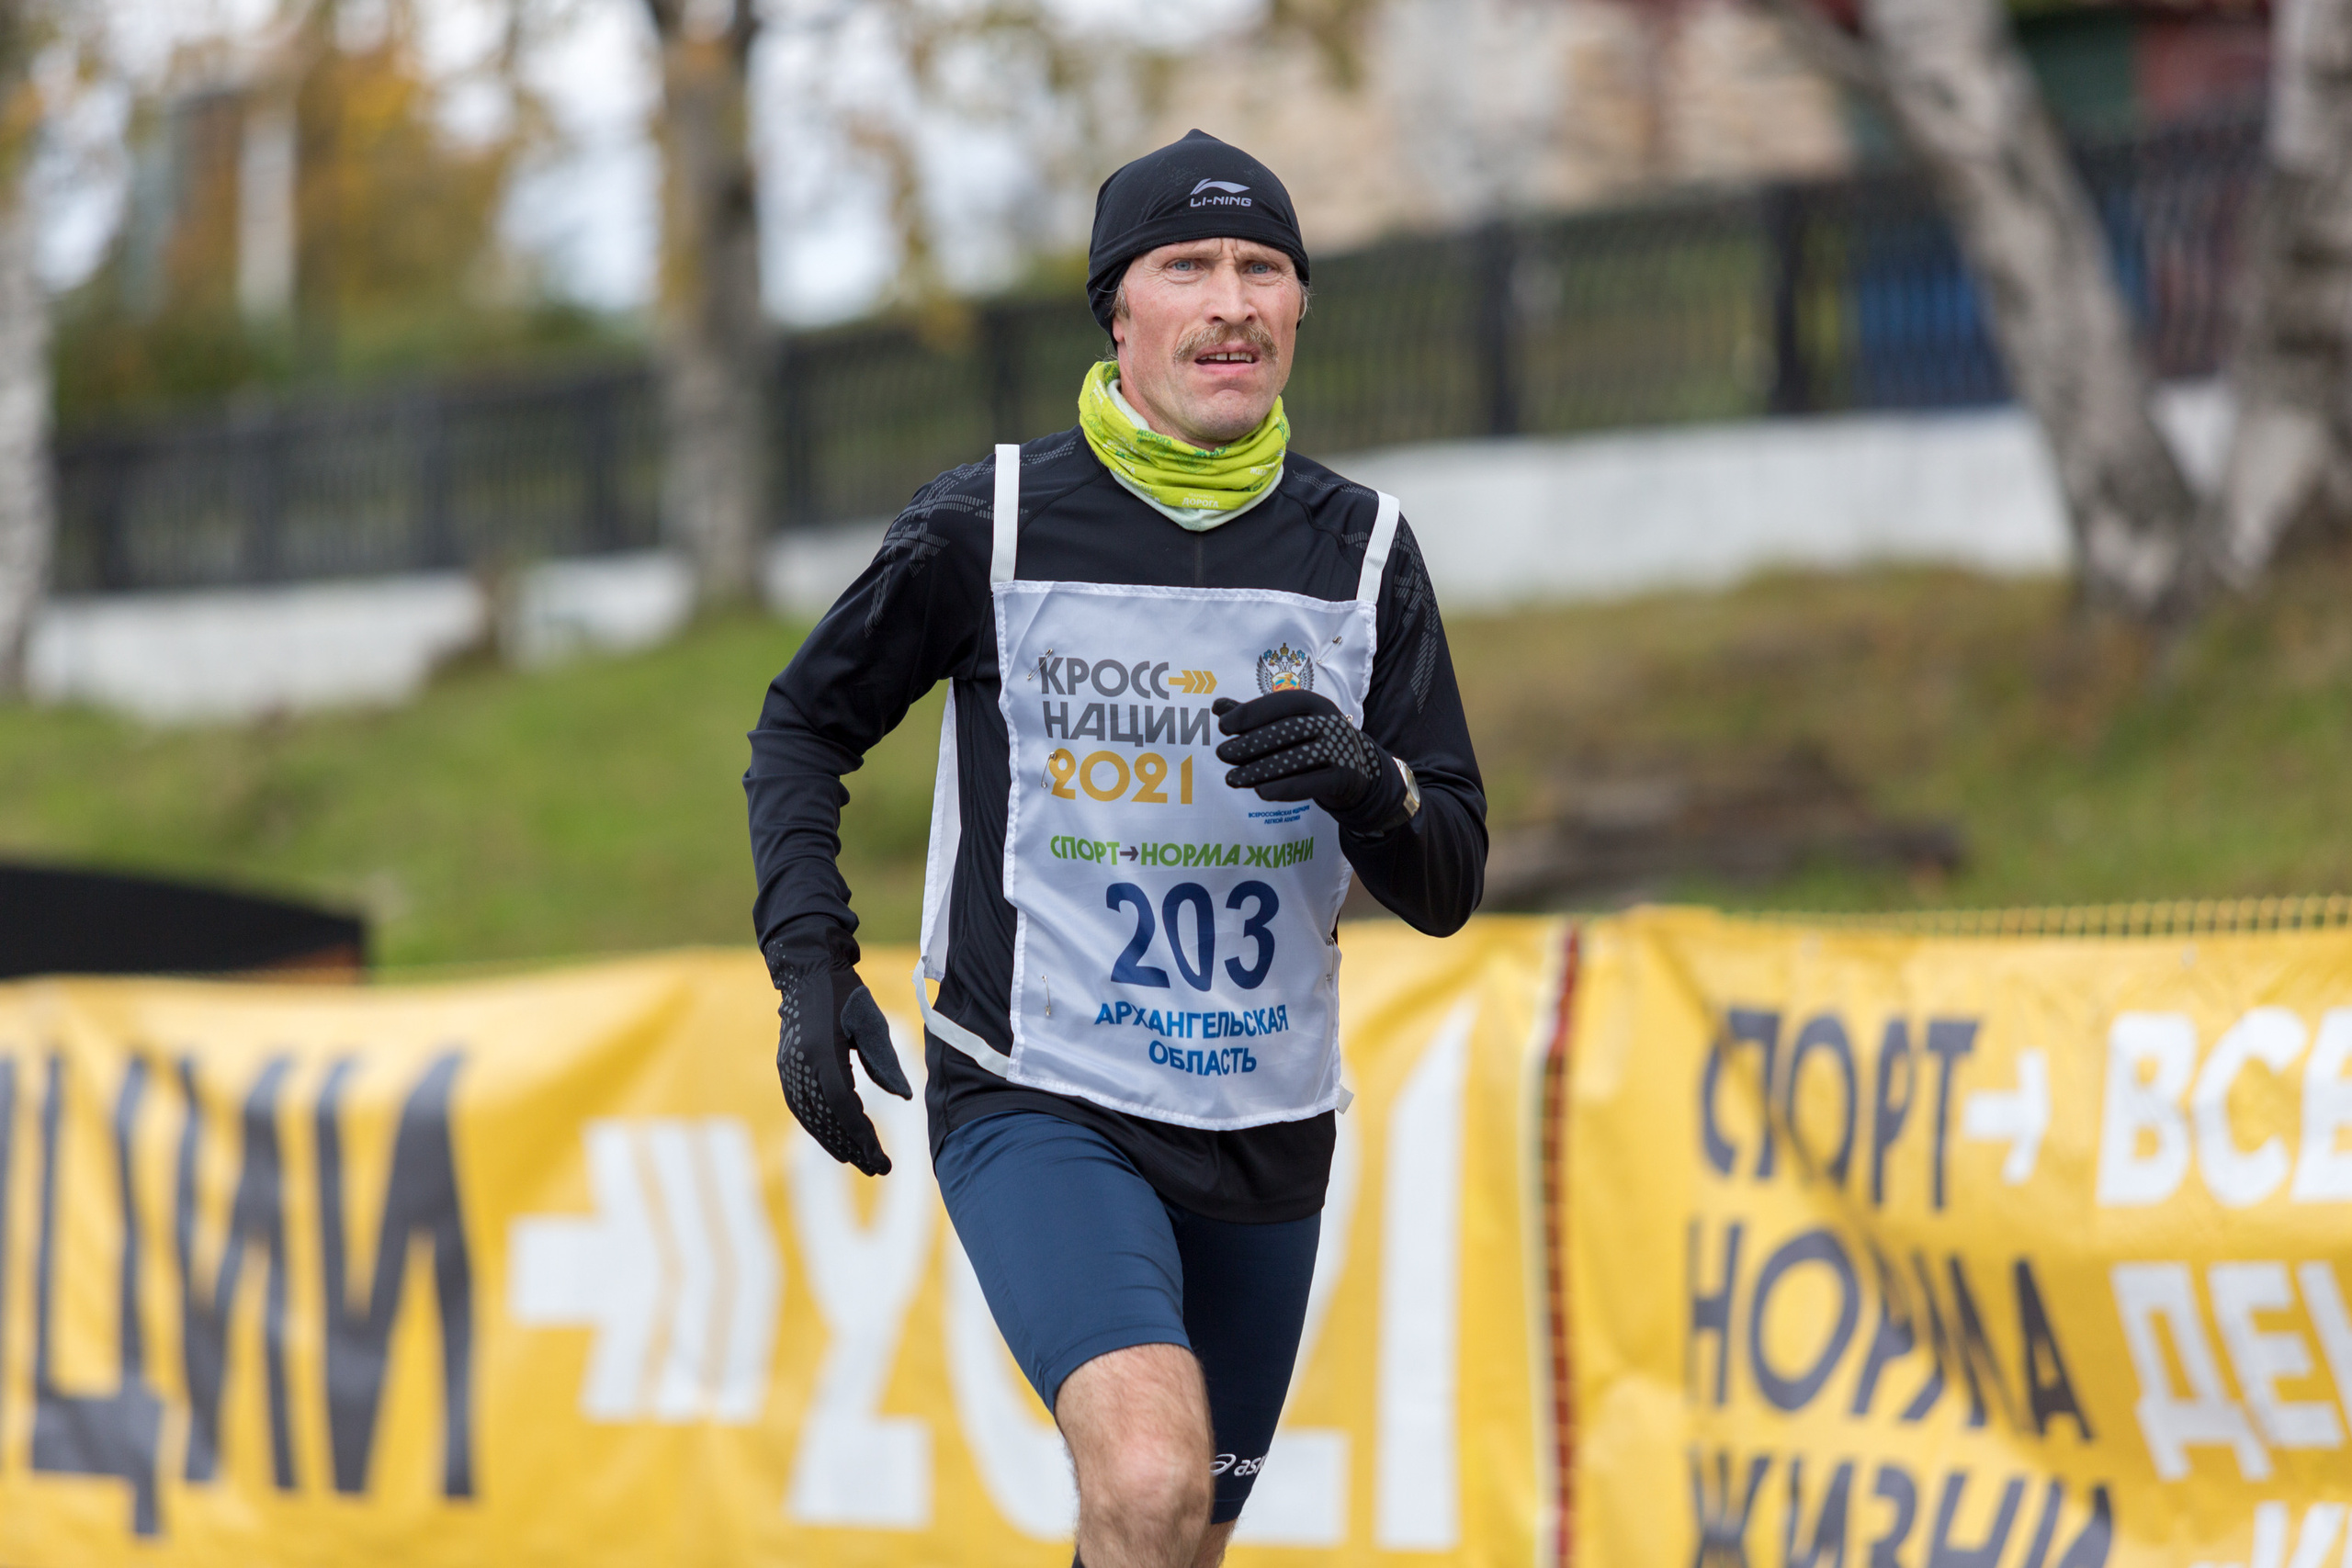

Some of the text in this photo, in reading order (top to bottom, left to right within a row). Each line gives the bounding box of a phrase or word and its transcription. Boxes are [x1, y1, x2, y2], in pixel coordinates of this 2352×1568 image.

[1190, 196, 1252, 208] LI-NING
[1182, 497, 1219, 508] ДОРОГА
[1038, 657, 1170, 700] КРОСС
[1042, 701, 1211, 747] НАЦИИ
[1048, 748, 1193, 805] 2021
[1050, 835, 1314, 868] СПОРТ НОРМА ЖИЗНИ
[1105, 880, 1280, 992] 203
[1094, 1000, 1289, 1039] АРХАНГЕЛЬСКАЯ
[1148, 1040, 1257, 1076] ОБЛАСТЬ
[1697, 1005, 1981, 1212] СПОРТ
[1685, 1218, 2098, 1442] НОРМА
